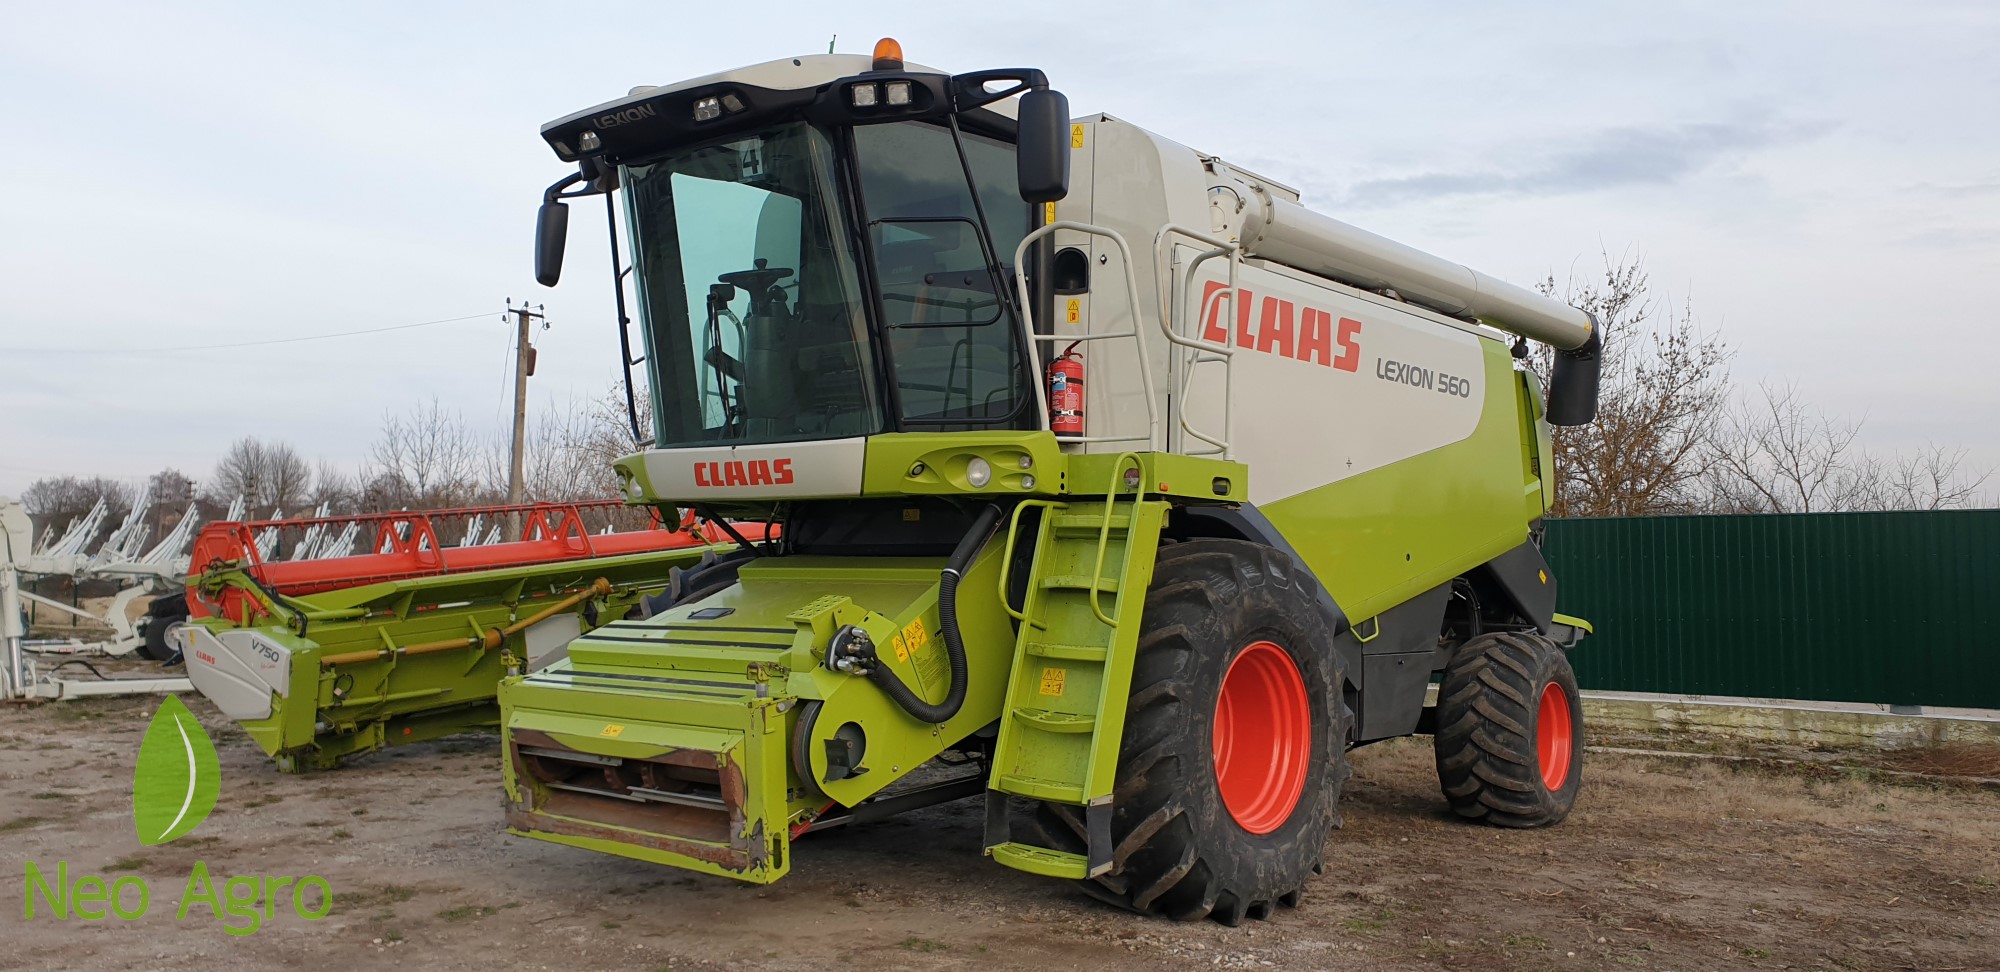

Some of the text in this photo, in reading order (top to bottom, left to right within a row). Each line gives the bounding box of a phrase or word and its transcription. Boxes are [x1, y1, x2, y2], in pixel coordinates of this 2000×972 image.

[594, 104, 656, 129] LEXION
[1198, 280, 1362, 373] CLAAS
[1376, 357, 1470, 399] LEXION 560
[694, 458, 794, 487] CLAAS
[196, 650, 216, 665] CLAAS
[252, 640, 279, 662] V750
